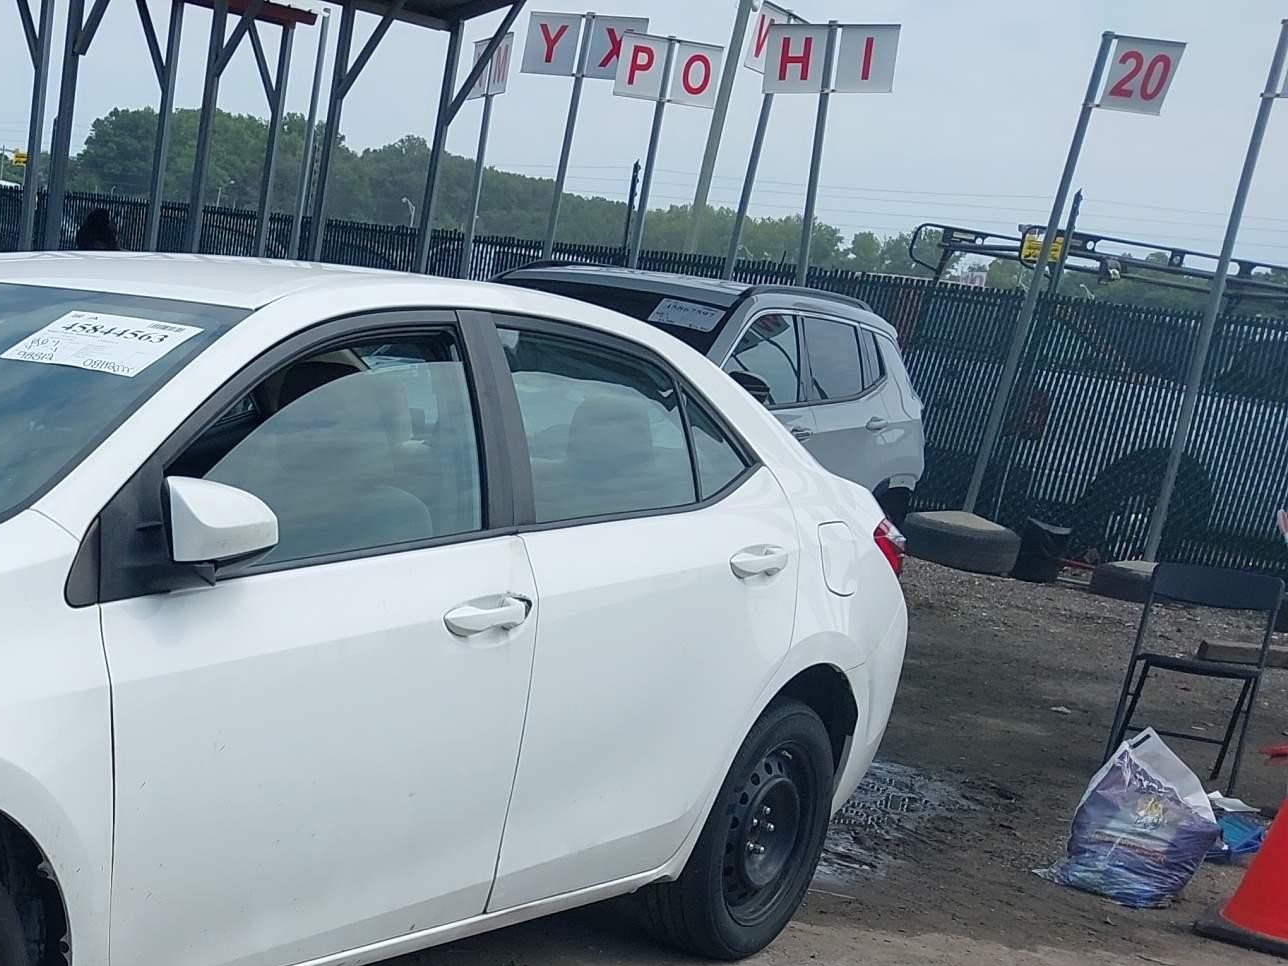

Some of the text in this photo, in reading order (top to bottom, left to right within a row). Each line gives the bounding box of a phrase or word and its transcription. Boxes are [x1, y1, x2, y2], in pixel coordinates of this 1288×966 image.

[539, 23, 569, 63] Y
[778, 36, 874, 81] H I
[627, 44, 711, 96] P O
[1108, 49, 1172, 102] 20
[61, 321, 169, 344] 45844563
